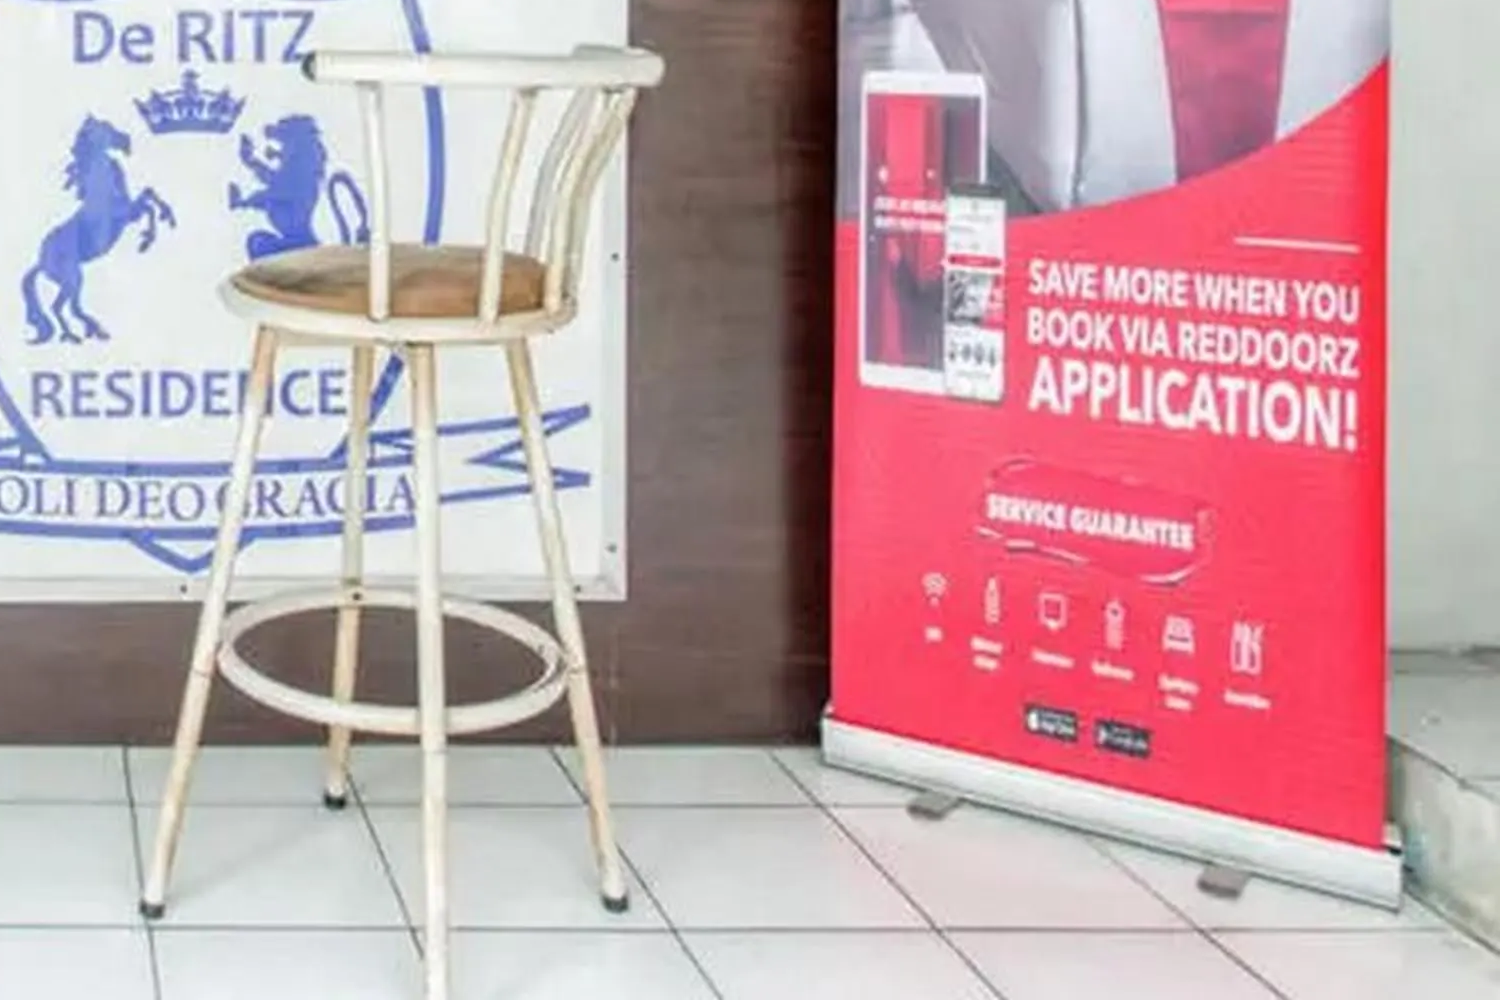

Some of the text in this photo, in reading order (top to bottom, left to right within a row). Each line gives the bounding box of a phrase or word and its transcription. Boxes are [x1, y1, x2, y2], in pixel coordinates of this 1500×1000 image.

[73, 10, 315, 63] De RITZ
[1028, 258, 1360, 324] SAVE MORE WHEN YOU
[1027, 307, 1115, 351] BOOK
[1119, 316, 1172, 359] VIA
[1178, 321, 1360, 379] REDDOORZ
[1027, 355, 1358, 452] APPLICATION!
[94, 474, 206, 521] DEO
[986, 493, 1195, 551] SERVICE GUARANTEE
